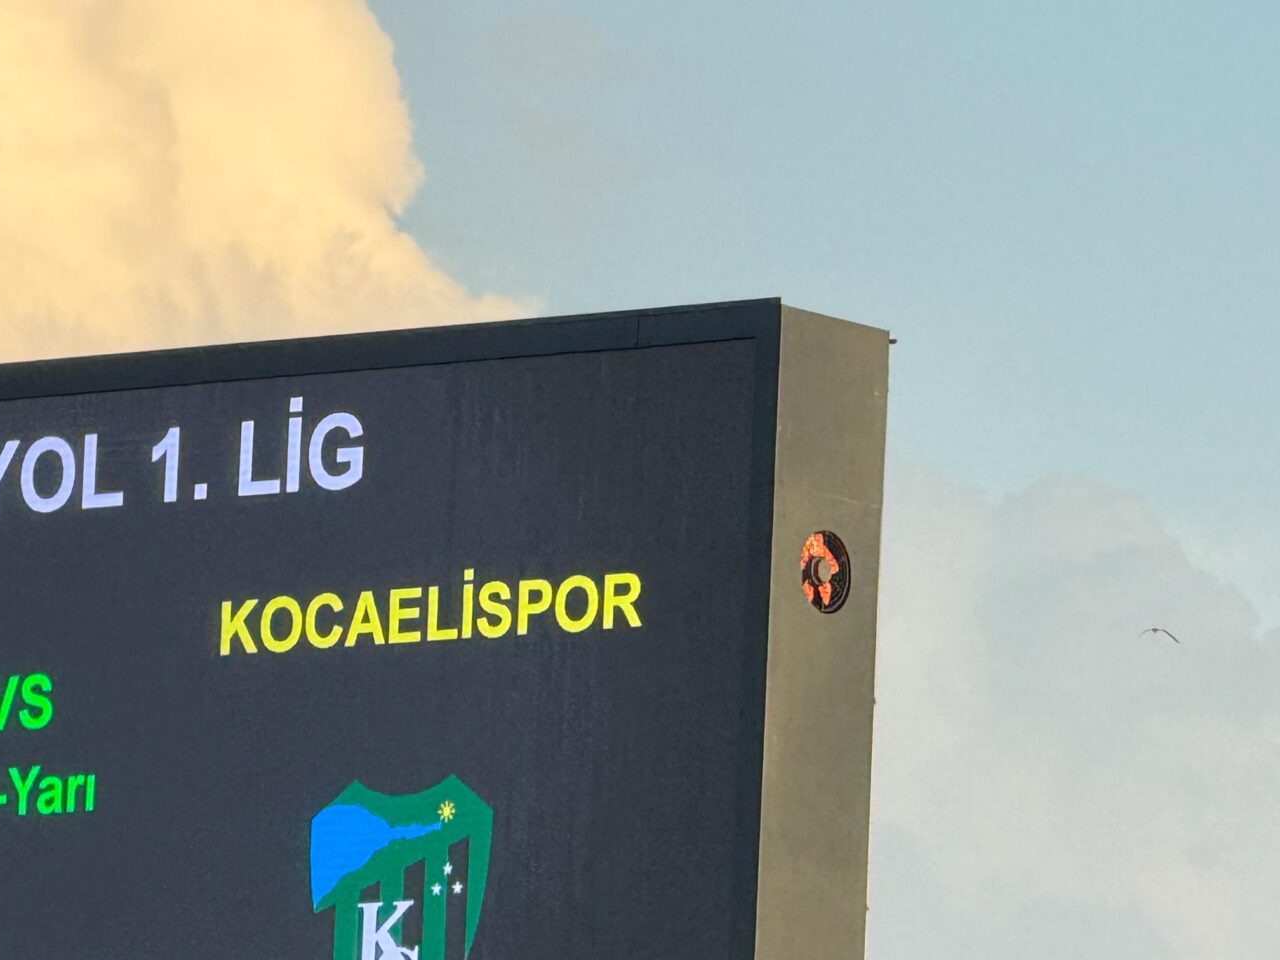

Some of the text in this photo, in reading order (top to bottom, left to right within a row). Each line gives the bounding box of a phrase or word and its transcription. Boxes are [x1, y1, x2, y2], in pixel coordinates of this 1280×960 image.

[152, 427, 211, 503] 1.
[237, 396, 364, 497] LİG
[219, 567, 644, 657] KOCAELİSPOR
